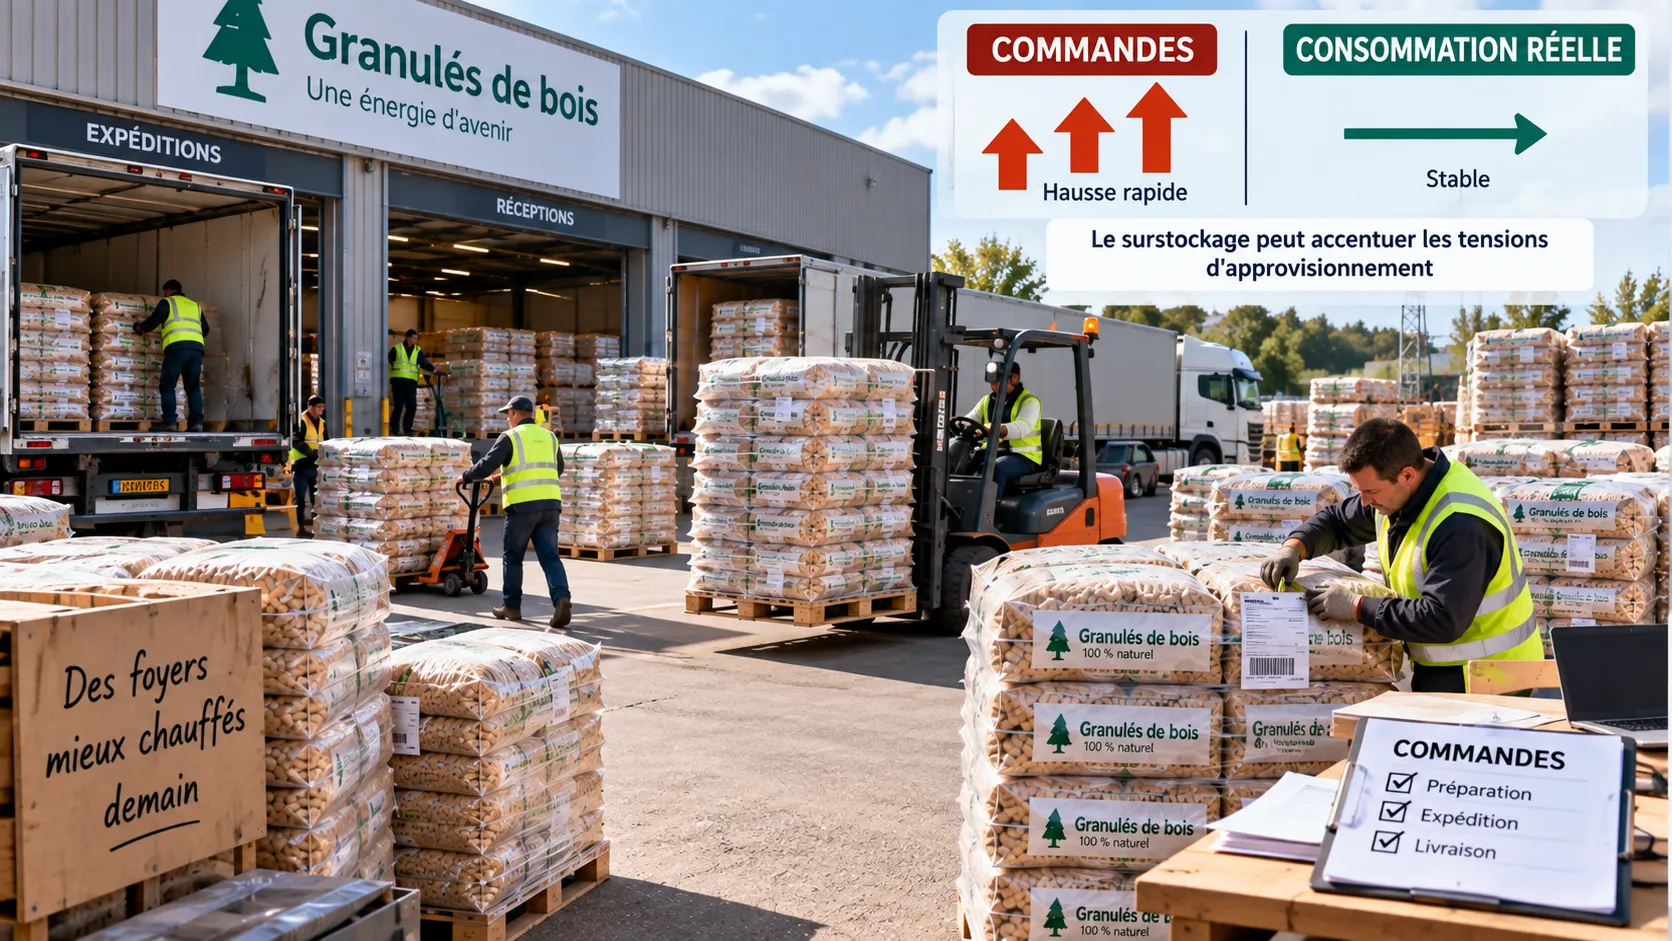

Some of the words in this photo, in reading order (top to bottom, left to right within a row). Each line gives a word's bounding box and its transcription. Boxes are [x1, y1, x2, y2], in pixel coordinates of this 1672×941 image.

[305, 13, 482, 97] Granulés
[492, 65, 530, 108] de
[541, 75, 598, 126] bois
[308, 76, 351, 106] Une
[360, 87, 436, 126] énergie
[443, 108, 512, 141] d'avenir
[87, 122, 221, 164] EXPÉDITIONS
[496, 197, 574, 226] RÉCEPTIONS
[1573, 508, 1584, 517] de
[1079, 627, 1142, 645] Granulés
[1147, 630, 1165, 645] de
[1170, 630, 1199, 646] bois
[1083, 648, 1100, 658] 100
[1104, 648, 1113, 658] %
[1117, 649, 1153, 659] naturel
[64, 666, 114, 709] Des
[130, 648, 208, 703] foyers
[46, 735, 125, 778] mieux
[139, 695, 245, 754] chauffés
[1080, 721, 1142, 738] Granulés
[1147, 723, 1164, 739] de
[1169, 724, 1198, 740] bois
[1253, 720, 1306, 737] Granulés
[1084, 741, 1102, 751] 100
[1105, 742, 1114, 752] %
[1118, 743, 1153, 753] naturel
[1394, 740, 1565, 770] COMMANDES
[104, 773, 199, 828] demain
[1427, 780, 1531, 801] Préparation
[1075, 817, 1137, 833] Granulés
[1142, 819, 1160, 834] de
[1164, 820, 1194, 836] bois
[1421, 809, 1518, 830] Expédition
[1080, 836, 1097, 846] 100
[1100, 837, 1110, 847] %
[1113, 837, 1149, 848] naturel
[1415, 839, 1496, 859] Livraison
[1076, 906, 1137, 923] Granulés
[1081, 926, 1098, 935] 100
[1101, 926, 1110, 935] %
[1114, 927, 1149, 936] naturel
